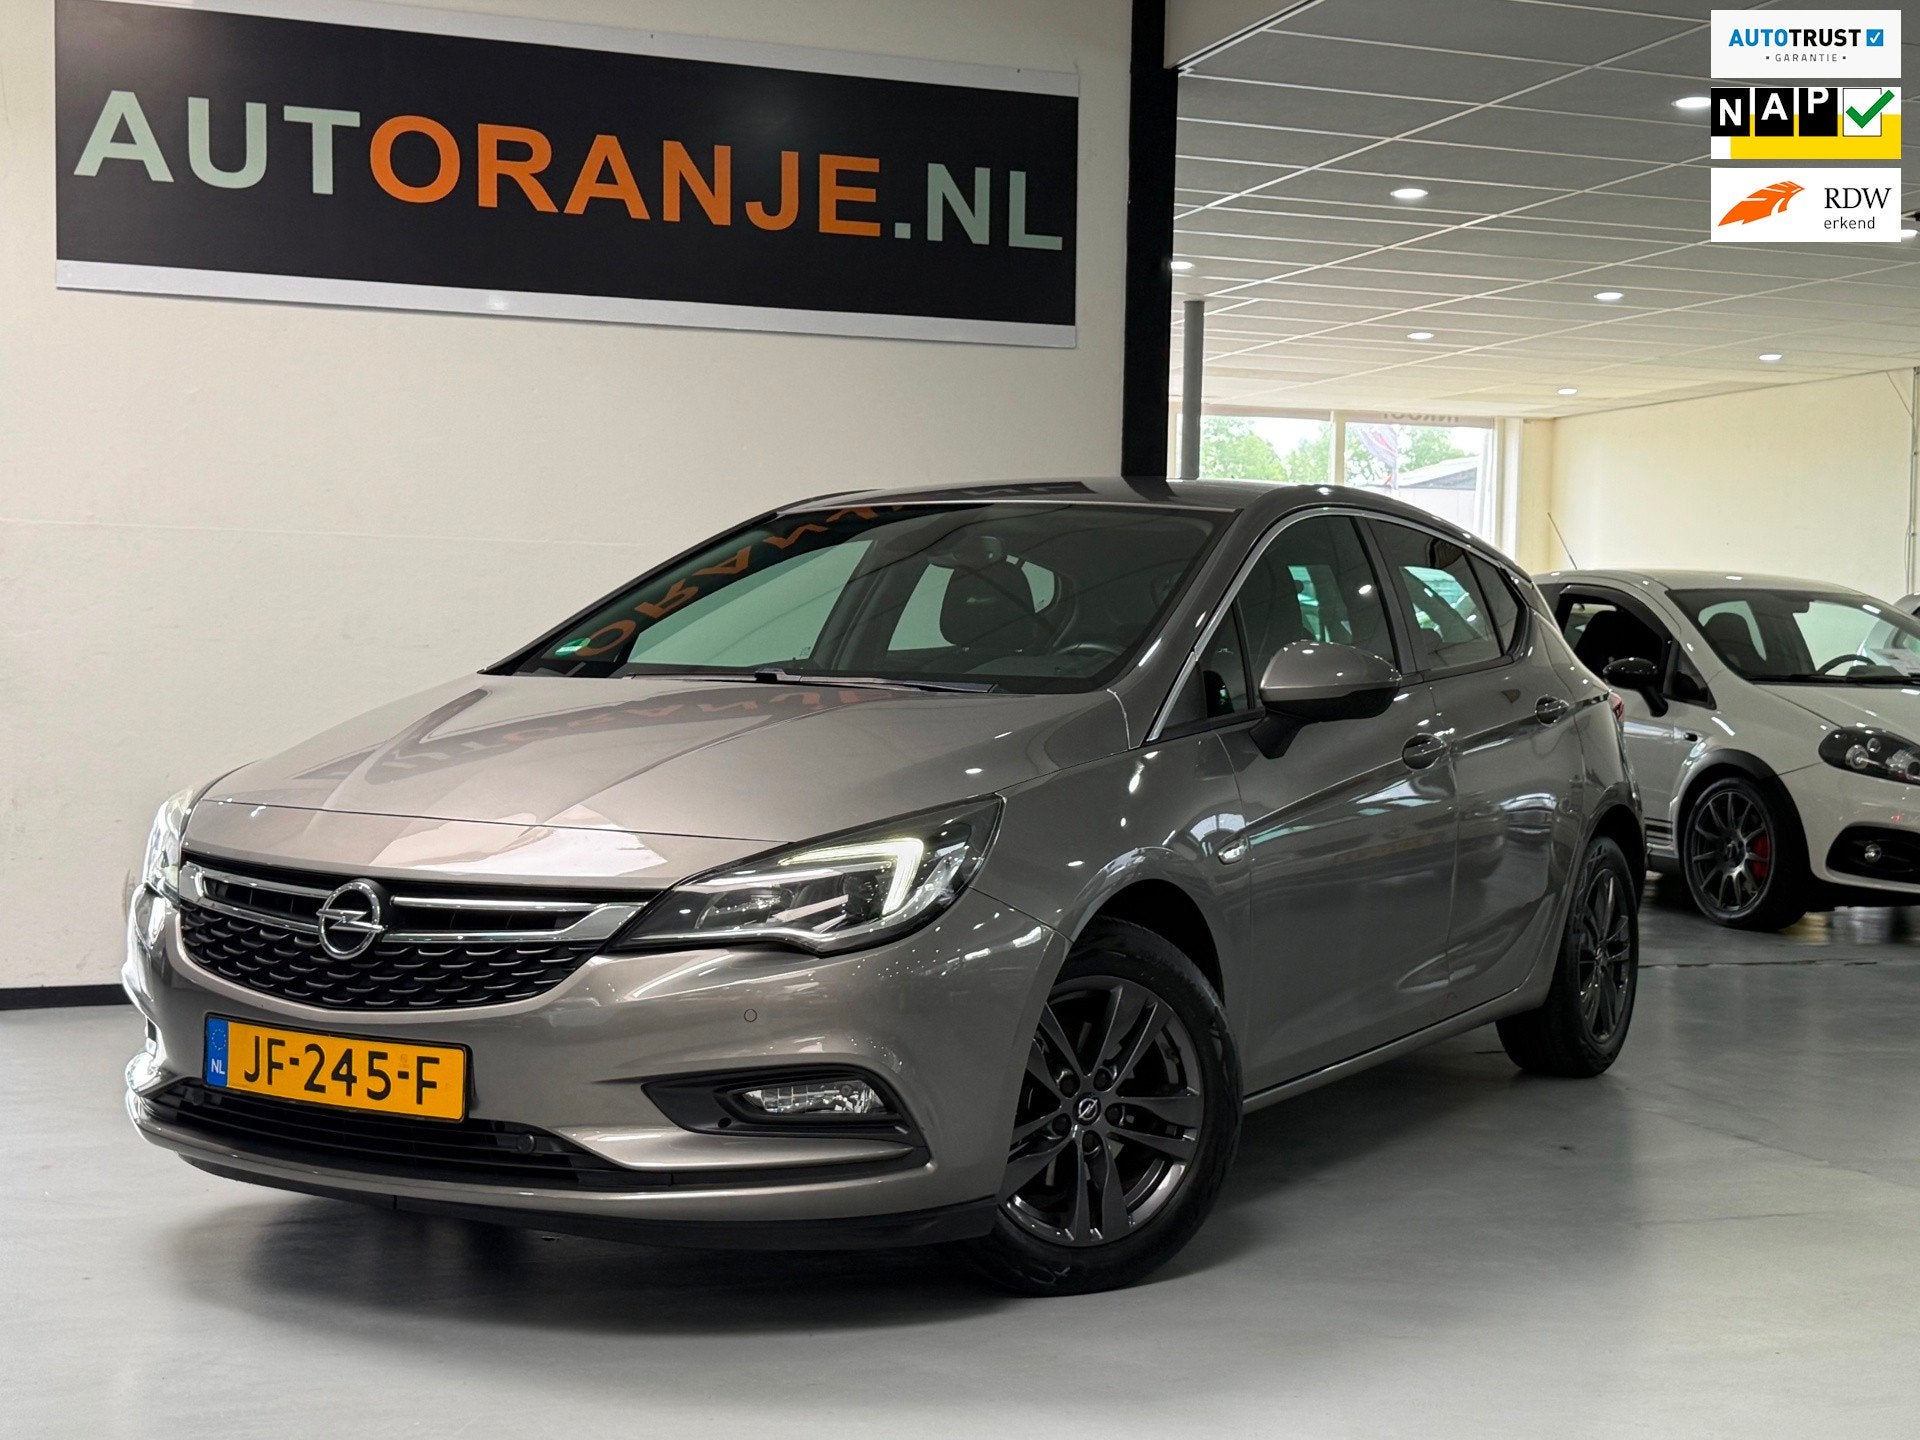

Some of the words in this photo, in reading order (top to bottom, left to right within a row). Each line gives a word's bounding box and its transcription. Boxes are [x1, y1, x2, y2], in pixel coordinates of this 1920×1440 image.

[73, 90, 1063, 250] AUTORANJE.NL
[211, 1059, 225, 1074] NL
[244, 1035, 439, 1105] JF-245-F
